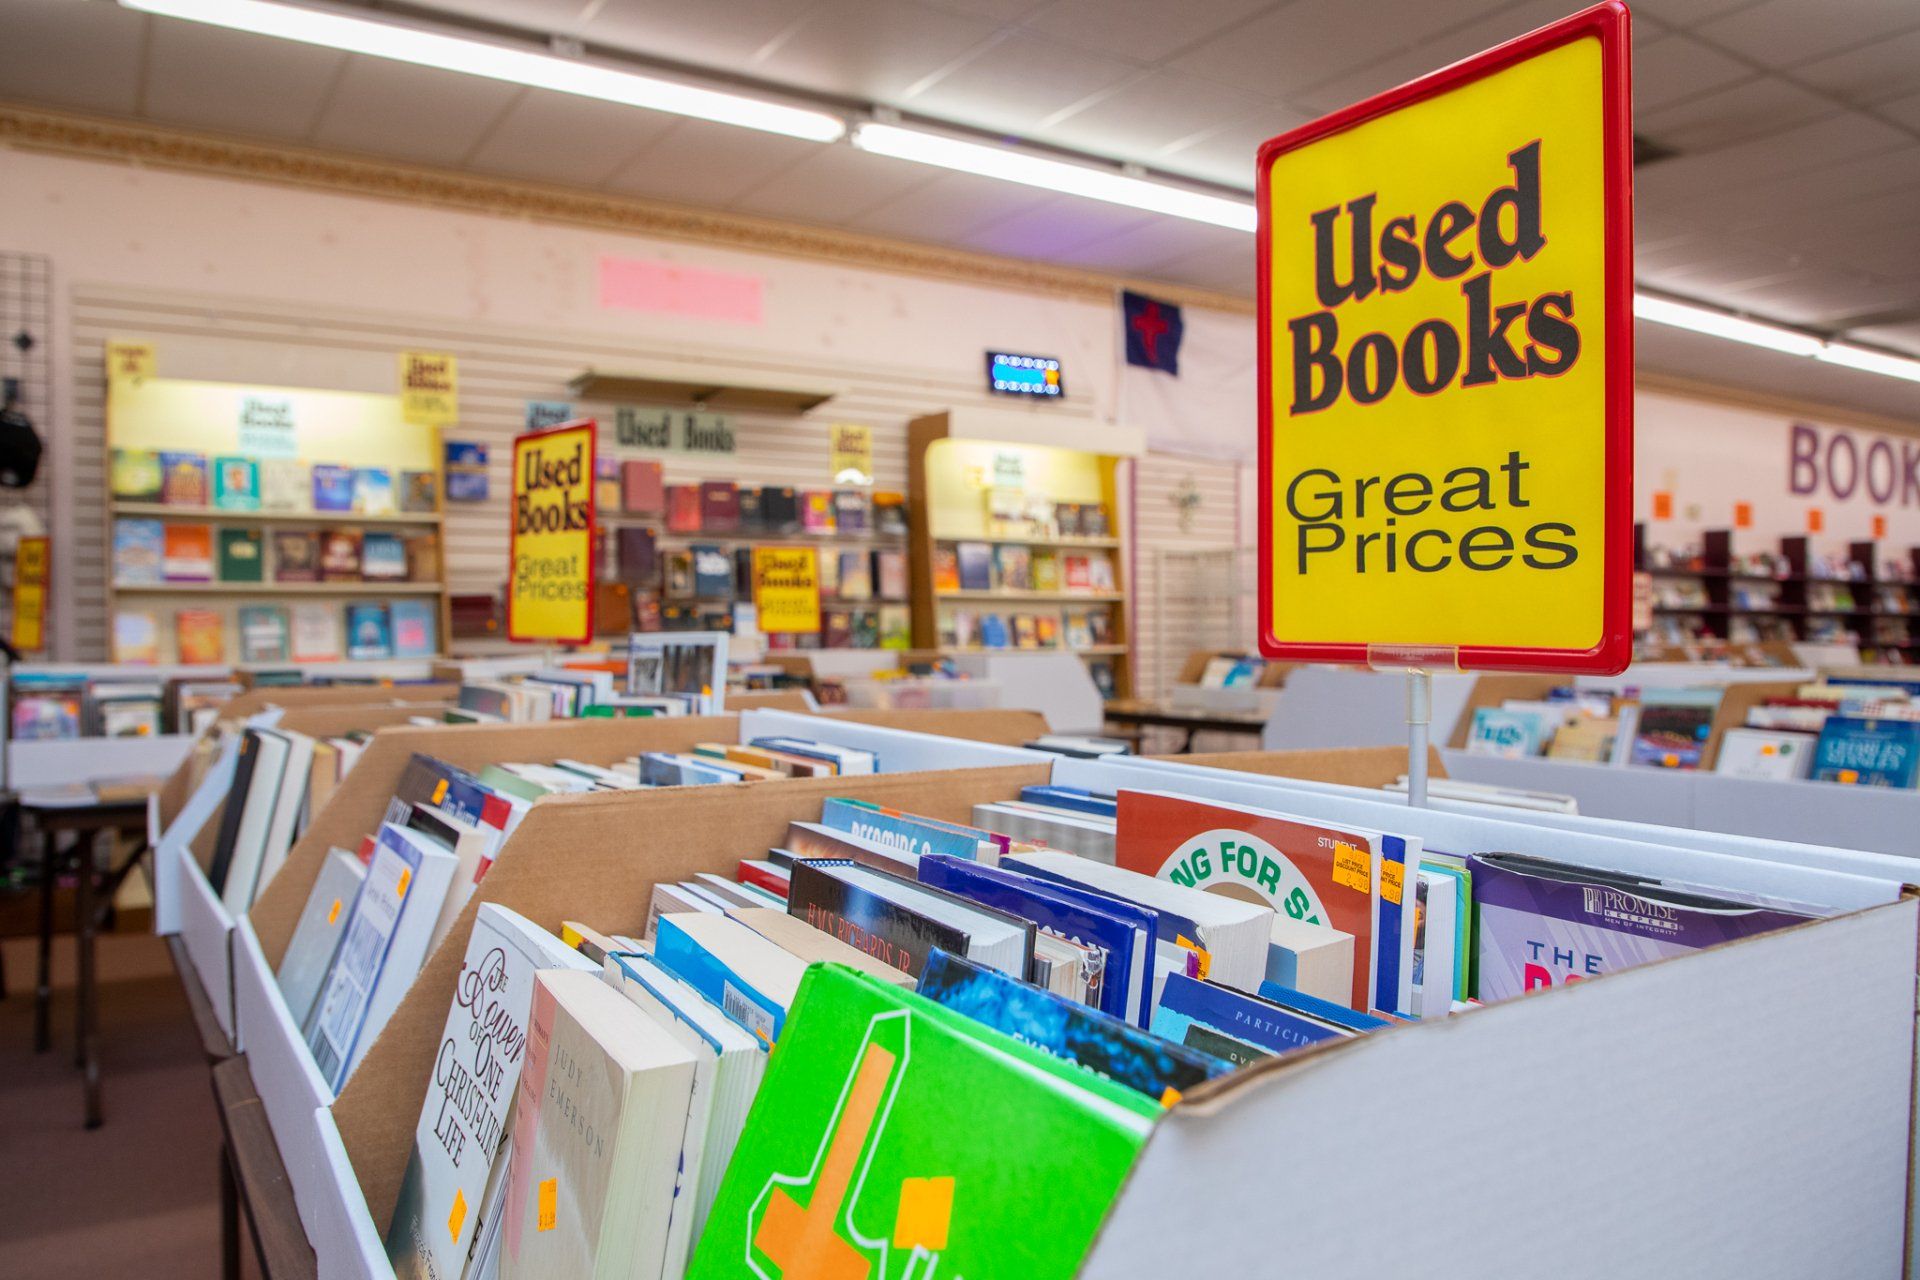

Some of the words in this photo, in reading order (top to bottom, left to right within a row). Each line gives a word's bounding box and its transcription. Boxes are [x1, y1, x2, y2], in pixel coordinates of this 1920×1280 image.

[1310, 138, 1548, 308] Used
[1289, 271, 1582, 417] Books
[617, 409, 670, 448] Used
[686, 414, 735, 452] Books
[525, 442, 583, 490] Used
[1286, 451, 1530, 523] Great
[517, 490, 588, 535] Books
[517, 554, 578, 579] Great
[1297, 518, 1579, 575] Prices
[517, 578, 587, 601] Prices
[1220, 841, 1281, 895] FOR
[1284, 886, 1320, 926] S
[1356, 867, 1368, 878] PRICE
[1604, 891, 1678, 922] PROMISE
[1604, 909, 1678, 930] KEEPERS
[1604, 917, 1621, 925] MEN
[1636, 924, 1677, 936] INTEGRITY
[1526, 940, 1603, 975] THE
[469, 1020, 485, 1047] OF
[475, 1032, 504, 1104] ONE
[554, 1044, 583, 1089] JUDY
[434, 1092, 466, 1169] LIFE
[549, 1078, 605, 1158] EMERSON
